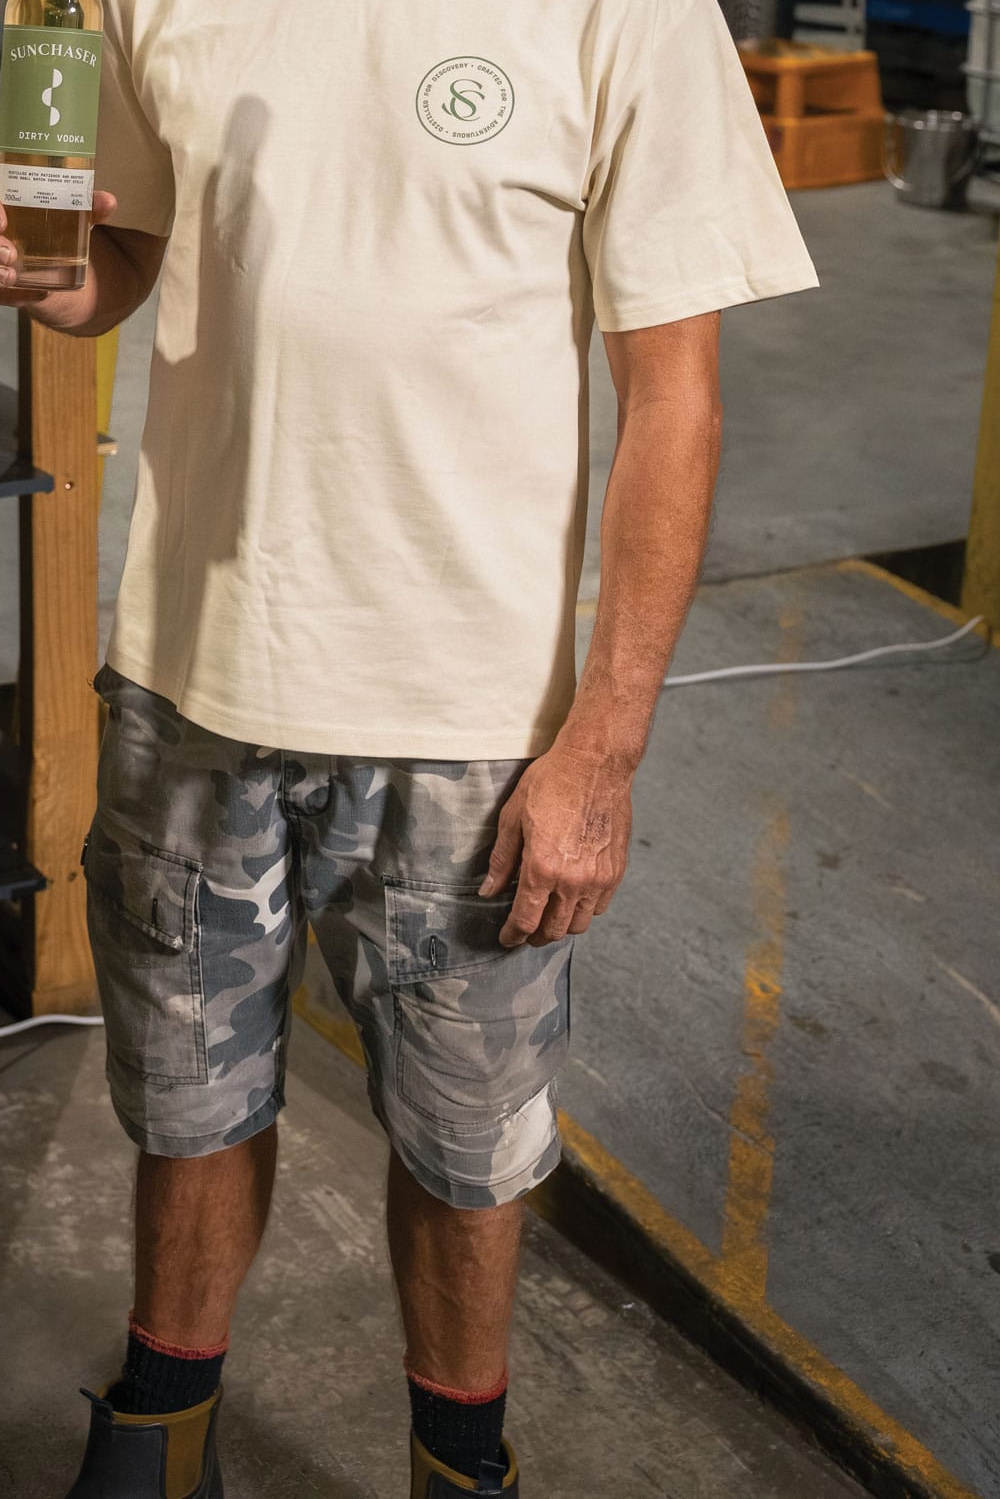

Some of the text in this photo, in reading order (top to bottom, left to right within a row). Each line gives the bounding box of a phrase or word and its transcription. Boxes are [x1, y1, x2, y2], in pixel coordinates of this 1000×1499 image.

[10, 44, 97, 68] SUNCHASER
[422, 63, 502, 132] DISTILLED FOR DISCOVERY CRAFTED
[497, 106, 506, 118] THE
[18, 131, 85, 144] DIRTY VODKA
[452, 120, 498, 139] ADVENTUROUS
